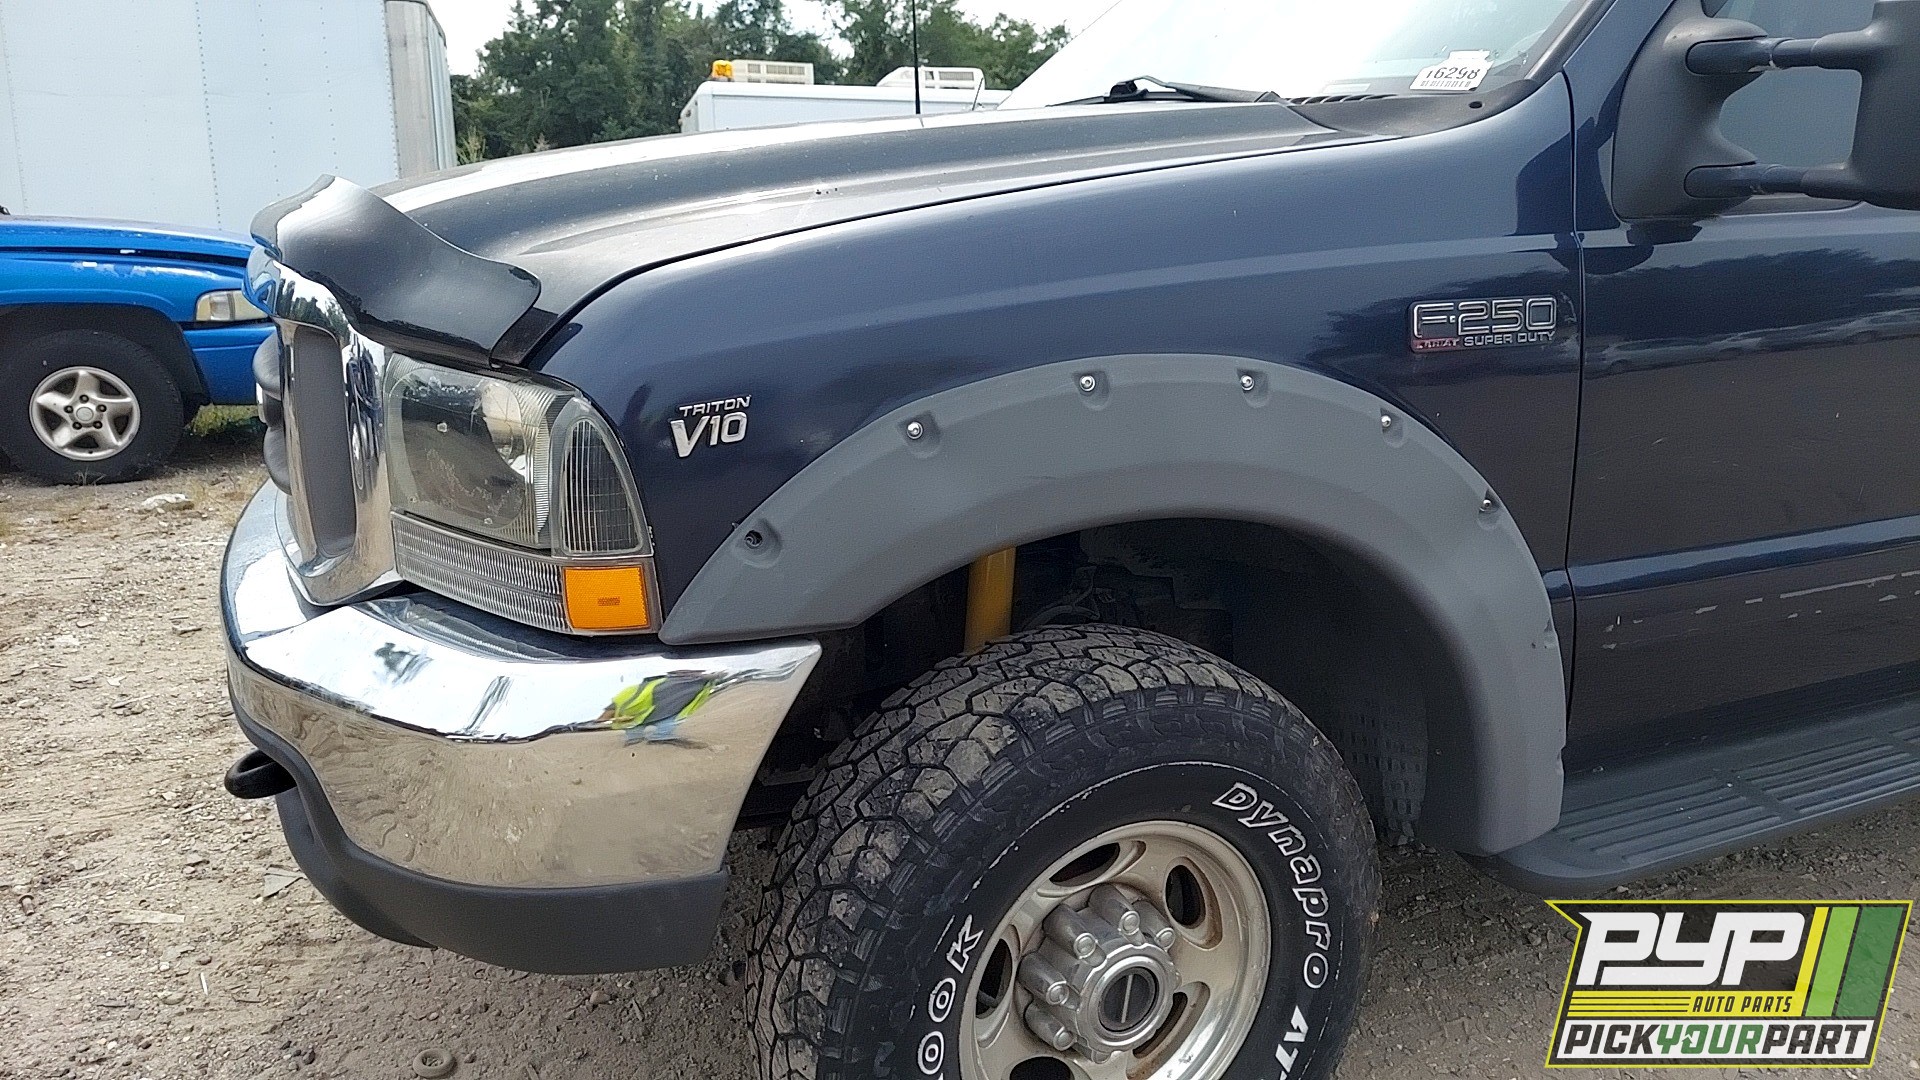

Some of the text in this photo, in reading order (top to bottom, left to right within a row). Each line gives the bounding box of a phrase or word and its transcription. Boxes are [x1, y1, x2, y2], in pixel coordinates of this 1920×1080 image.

[1463, 333, 1513, 347] SUPER
[1517, 330, 1556, 343] DUTY
[679, 395, 752, 417] TRITON
[670, 411, 747, 458] V10
[1213, 782, 1332, 988] Dynapro
[917, 914, 984, 1080] OOK
